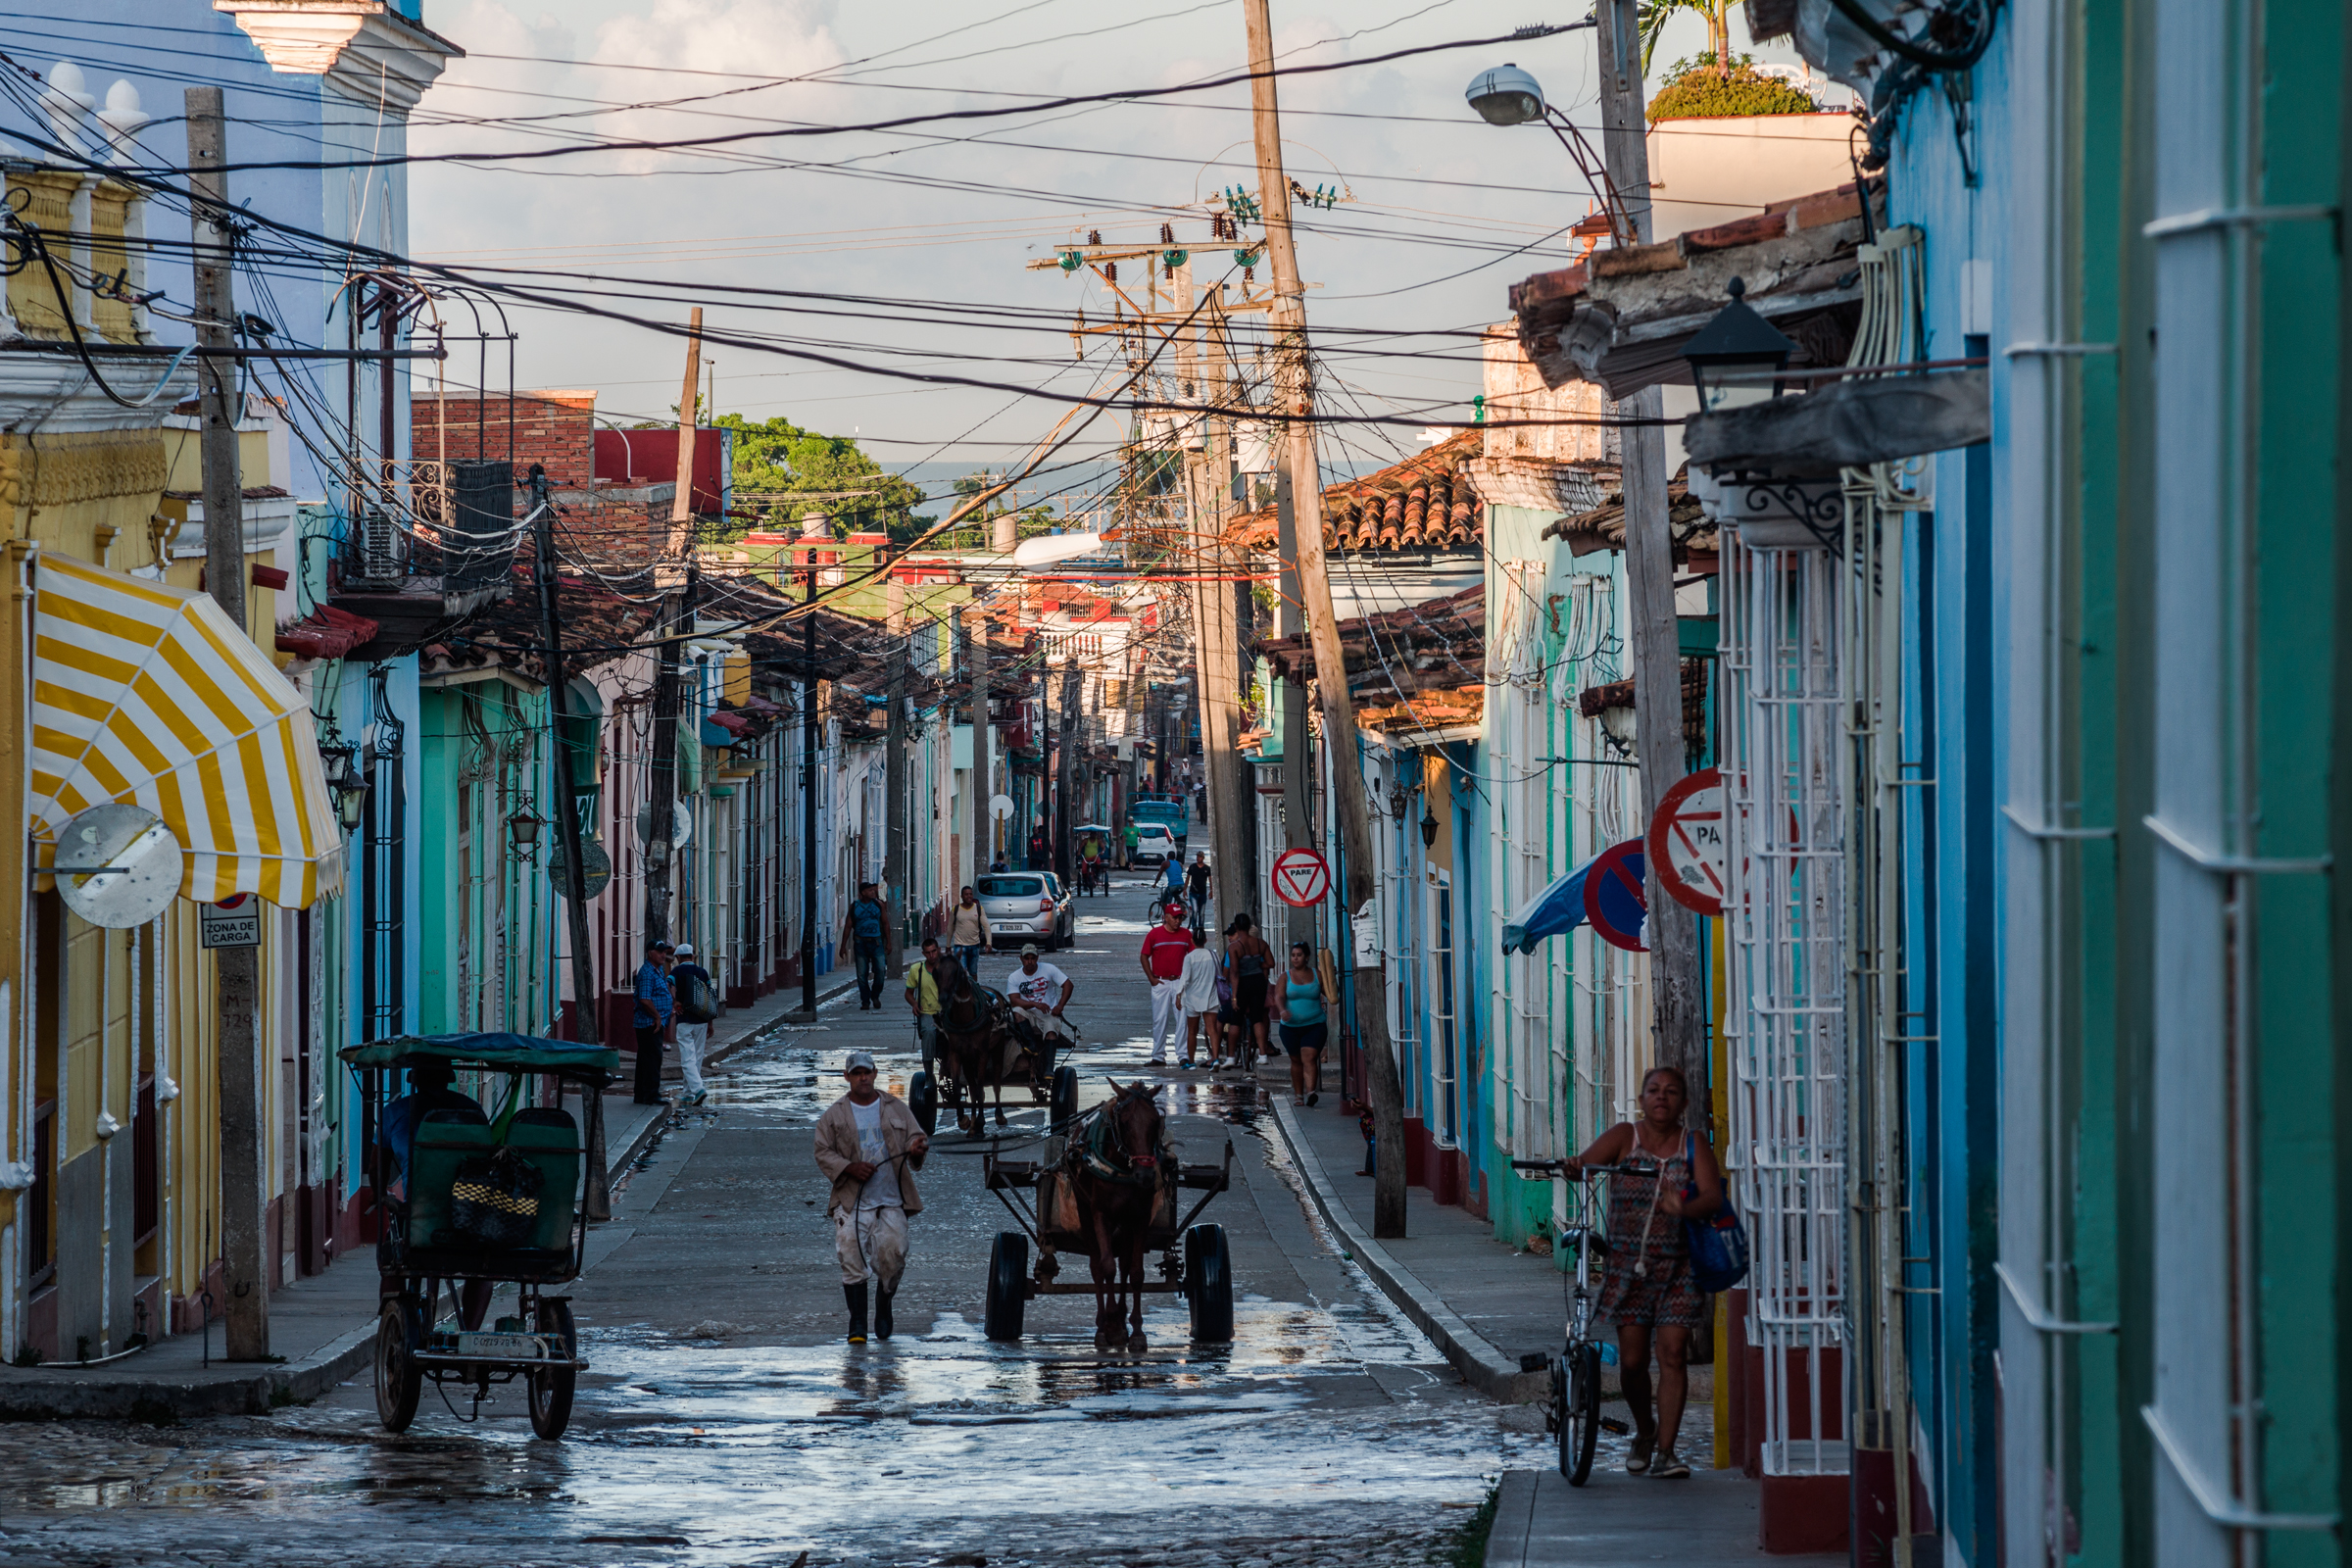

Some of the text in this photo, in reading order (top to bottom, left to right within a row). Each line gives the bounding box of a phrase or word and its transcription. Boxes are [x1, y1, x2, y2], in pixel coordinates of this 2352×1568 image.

[207, 921, 255, 933] ZONA DE
[212, 932, 251, 943] CARGA
[222, 1014, 252, 1028] 729
